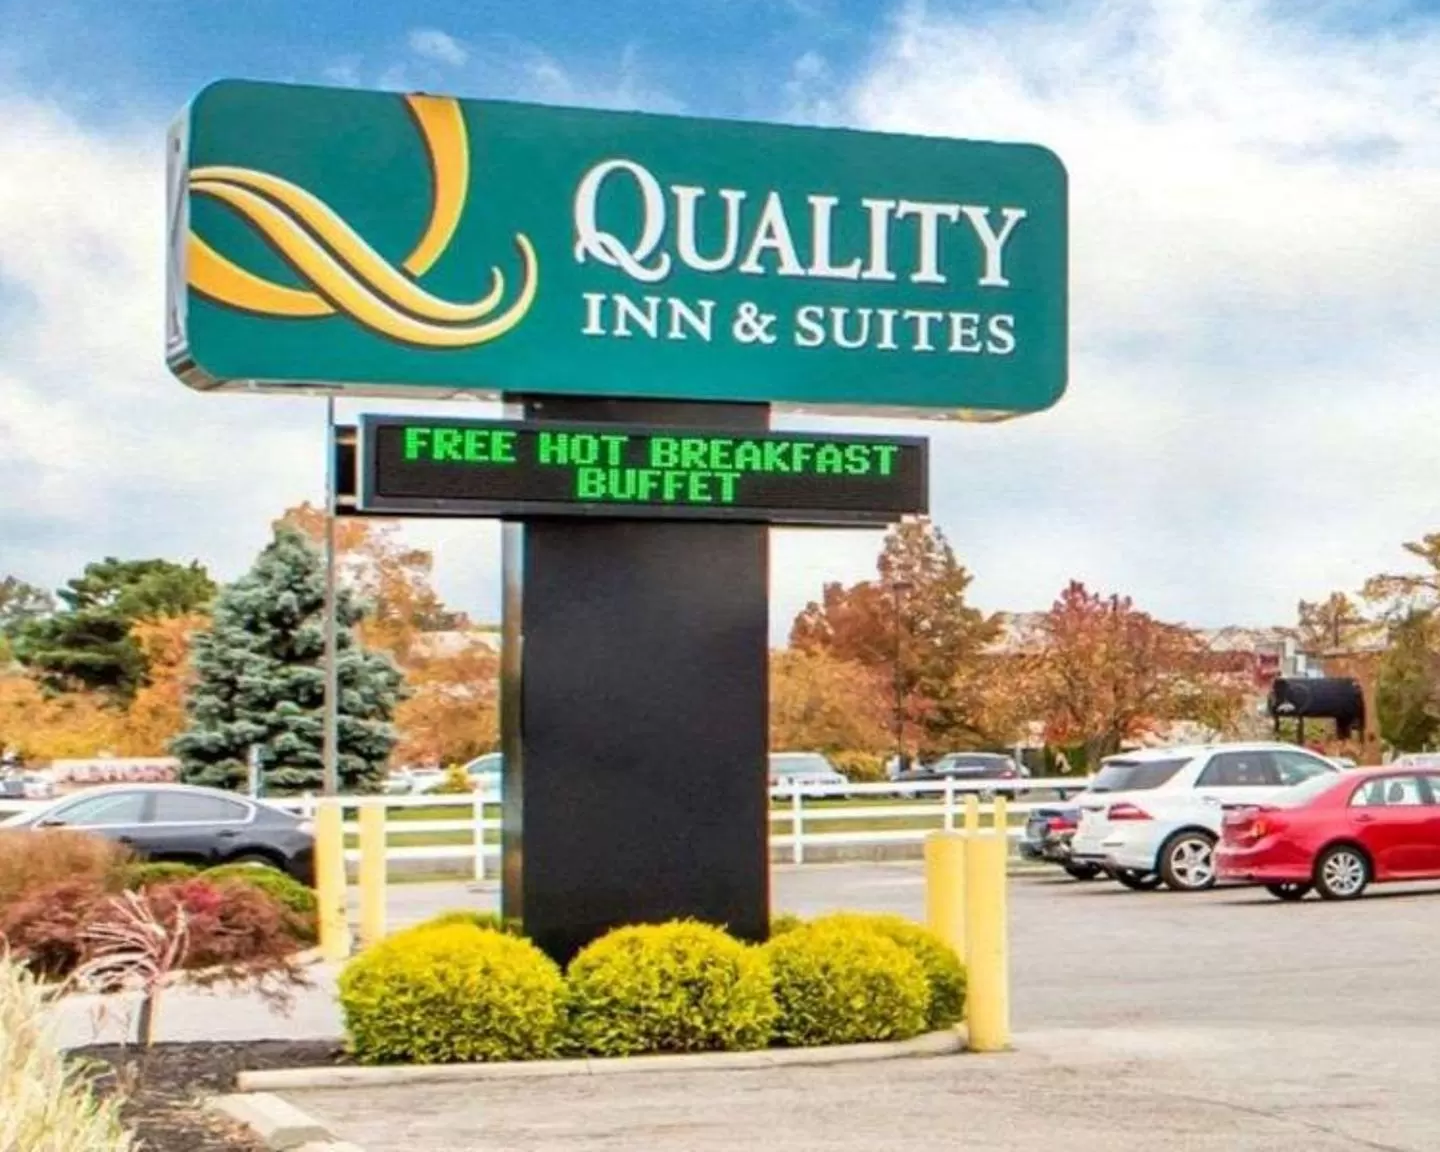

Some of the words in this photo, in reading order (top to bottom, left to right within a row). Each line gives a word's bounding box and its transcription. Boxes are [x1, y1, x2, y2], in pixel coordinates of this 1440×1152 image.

[574, 159, 1026, 286] QUALITY
[581, 292, 716, 341] INN
[732, 301, 777, 344] &
[795, 305, 1016, 354] SUITES
[404, 427, 517, 463] FREE
[538, 432, 629, 467] HOT
[650, 437, 898, 475] BREAKFAST
[577, 466, 741, 502] BUFFET
